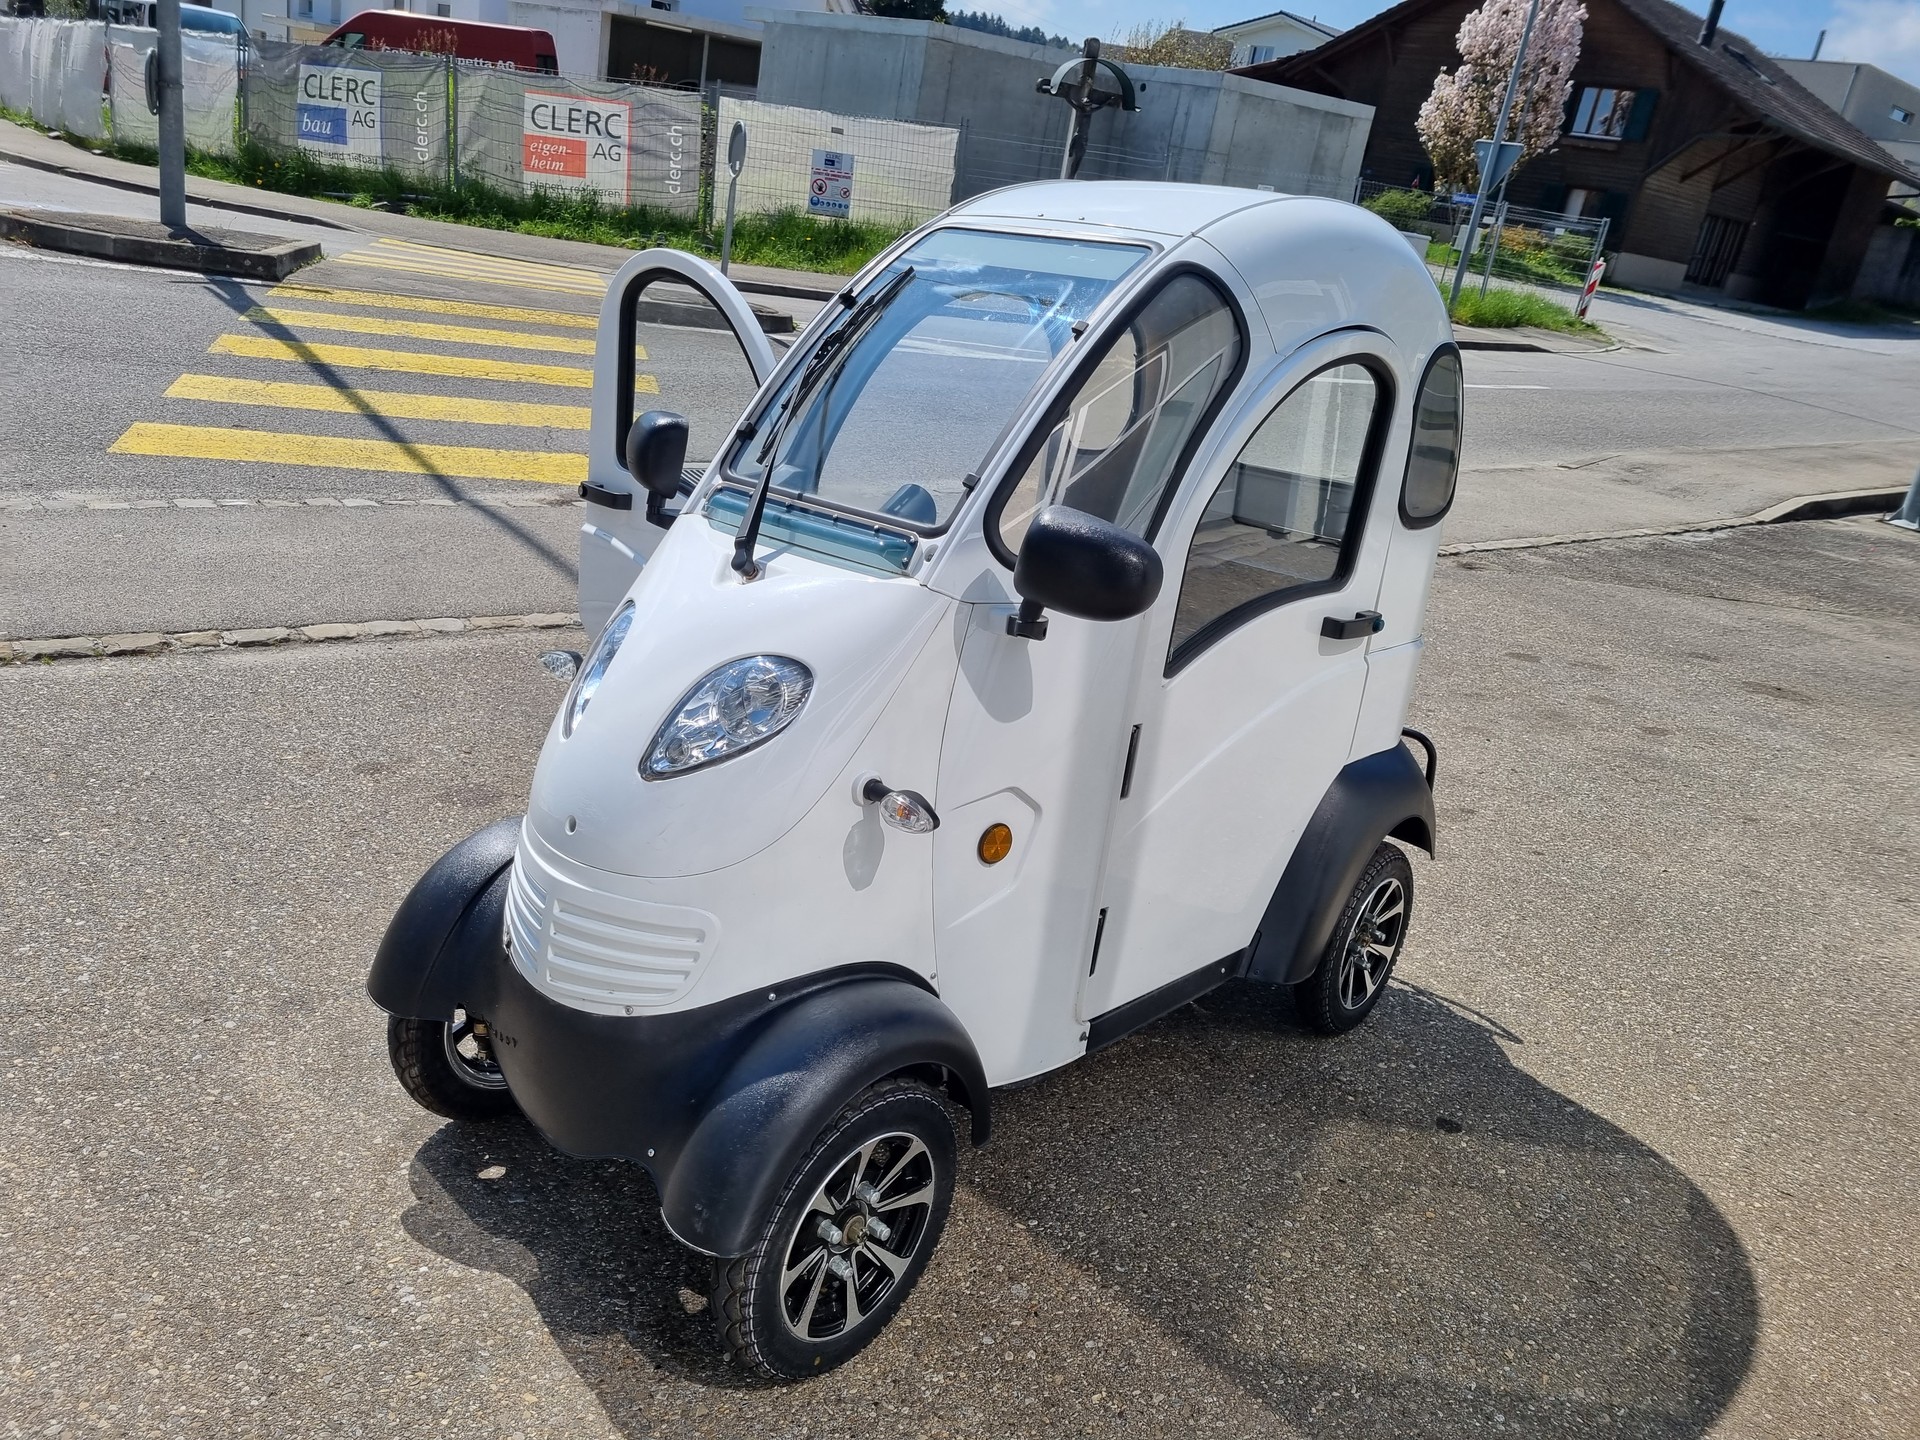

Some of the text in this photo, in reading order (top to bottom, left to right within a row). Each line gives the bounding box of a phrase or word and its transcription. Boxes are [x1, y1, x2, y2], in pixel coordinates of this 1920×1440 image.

[304, 73, 375, 105] CLERC
[302, 113, 332, 134] bau
[351, 110, 375, 129] AG
[413, 91, 429, 161] clerc.ch
[531, 103, 622, 139] CLERC
[530, 140, 572, 156] eigen-
[592, 143, 621, 161] AG
[348, 153, 378, 165] tiefbau
[530, 155, 564, 171] heim
[664, 125, 683, 194] clerc.ch
